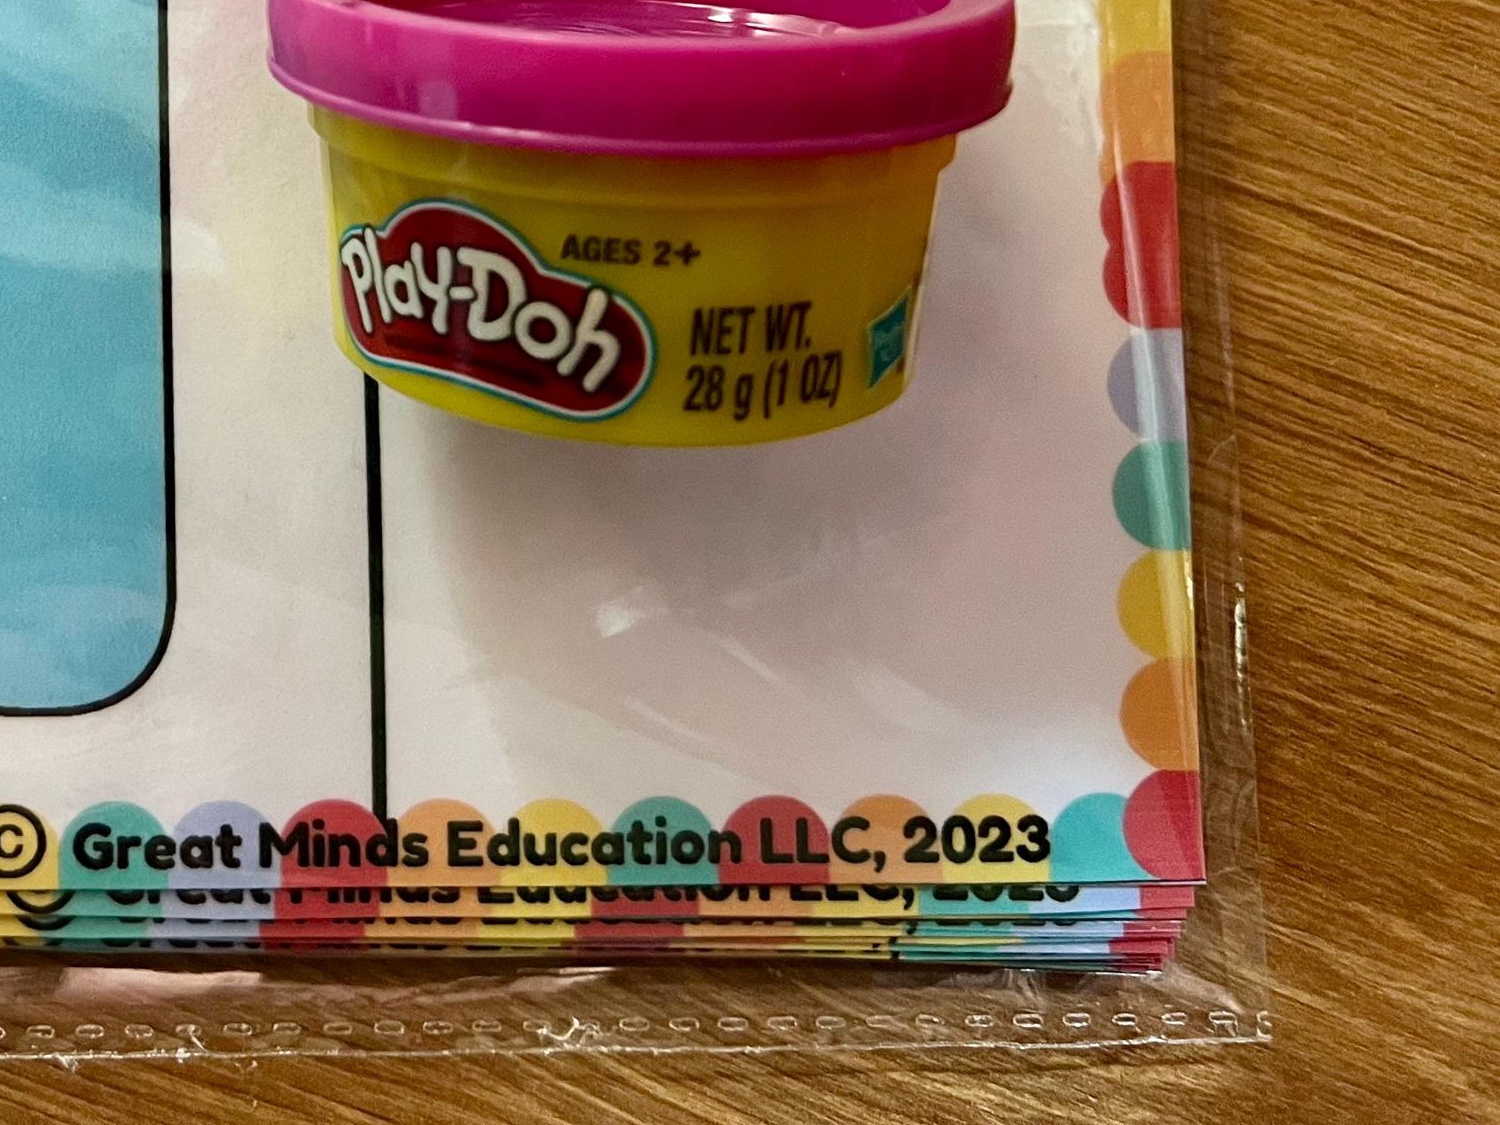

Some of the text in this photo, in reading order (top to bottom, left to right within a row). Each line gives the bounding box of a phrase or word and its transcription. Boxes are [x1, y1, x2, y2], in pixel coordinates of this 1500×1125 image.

[561, 234, 701, 267] AGES 2+
[341, 227, 620, 392] Play-Doh
[690, 305, 756, 356] NET
[766, 300, 812, 352] WT.
[683, 349, 843, 421] 28 g (1 OZ)
[73, 822, 242, 871] Great
[258, 818, 429, 869] Minds
[447, 816, 743, 868] Education
[760, 817, 887, 872] LLC,
[902, 814, 1051, 864] 2023
